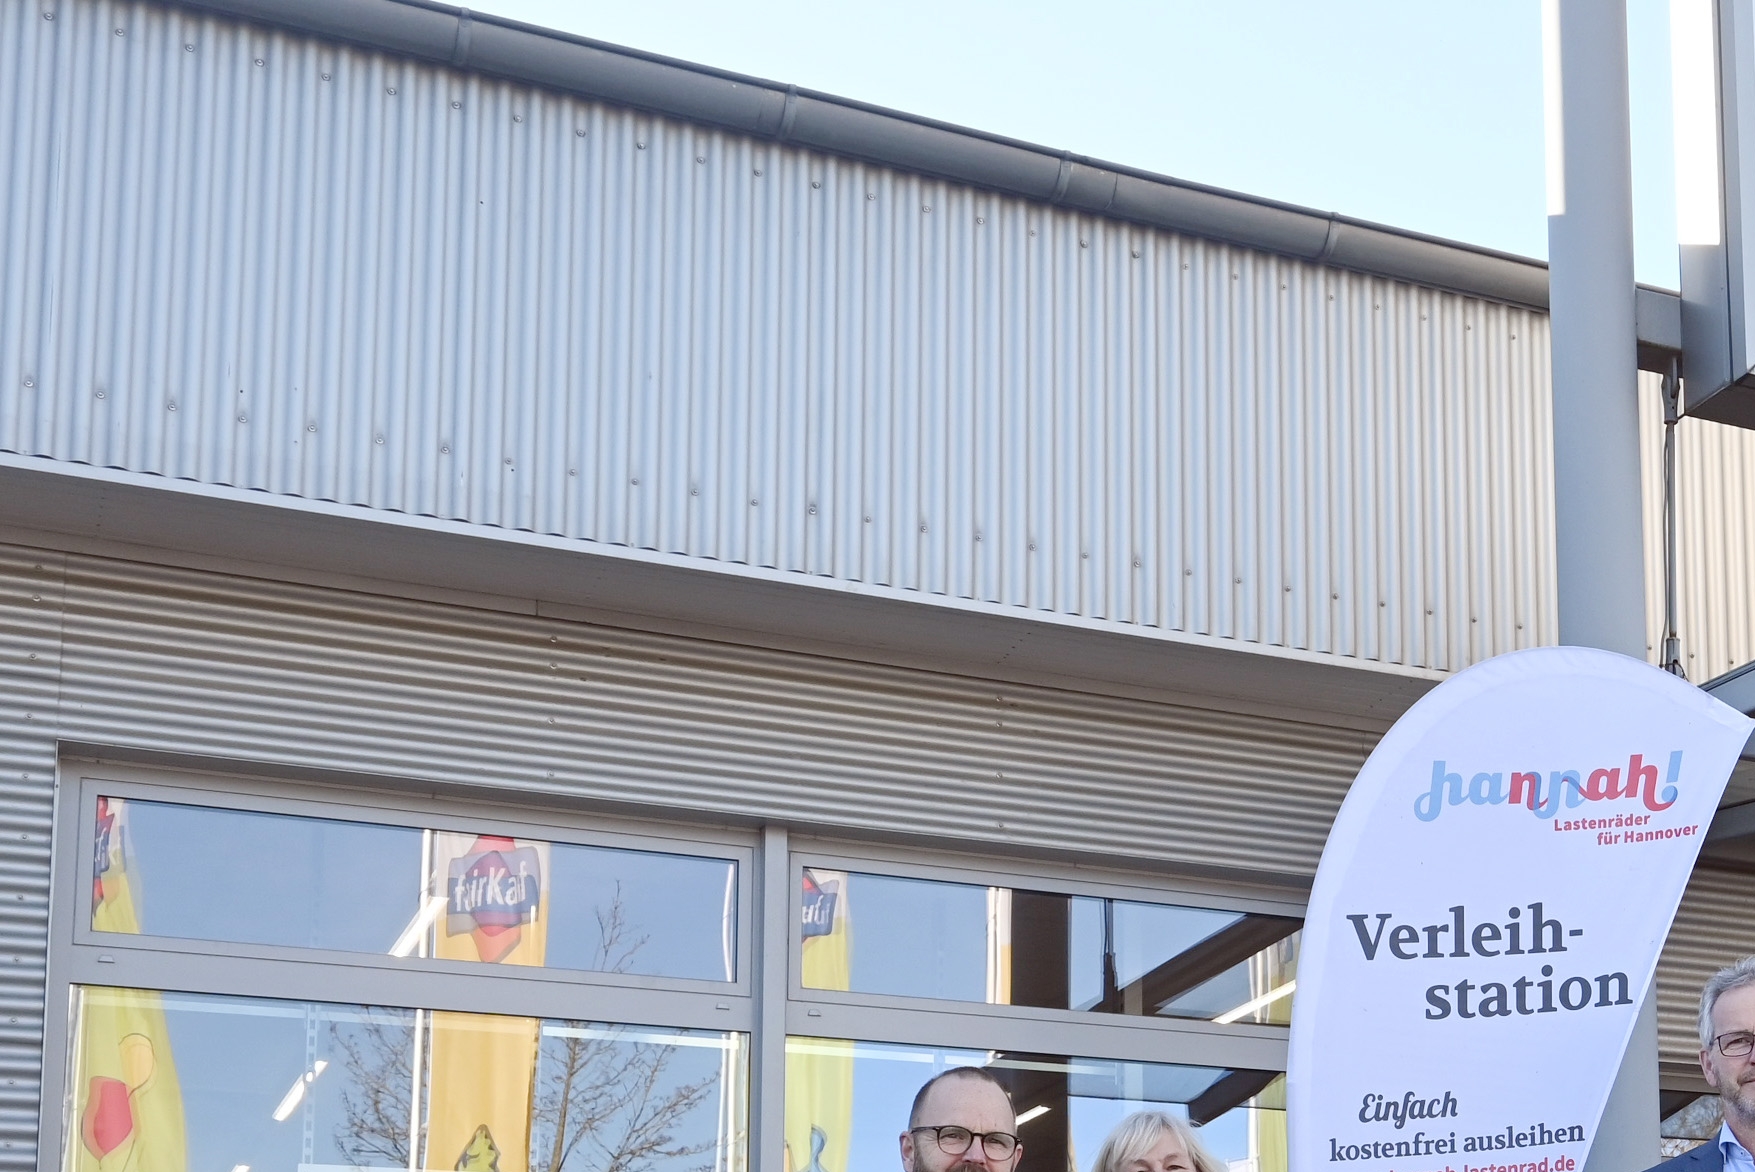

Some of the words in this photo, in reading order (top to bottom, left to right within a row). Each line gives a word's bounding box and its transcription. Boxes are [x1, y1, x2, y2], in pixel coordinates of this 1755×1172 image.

[1413, 750, 1683, 822] hannah!
[1553, 813, 1652, 832] Lastenräder
[1597, 831, 1620, 846] für
[1624, 823, 1698, 845] Hannover
[455, 861, 527, 911] fairKaf
[1347, 903, 1583, 961] Verleih-
[1425, 965, 1633, 1020] station
[1358, 1091, 1458, 1130] Einfach
[1330, 1132, 1457, 1162] kostenfrei
[1463, 1123, 1585, 1152] ausleihen
